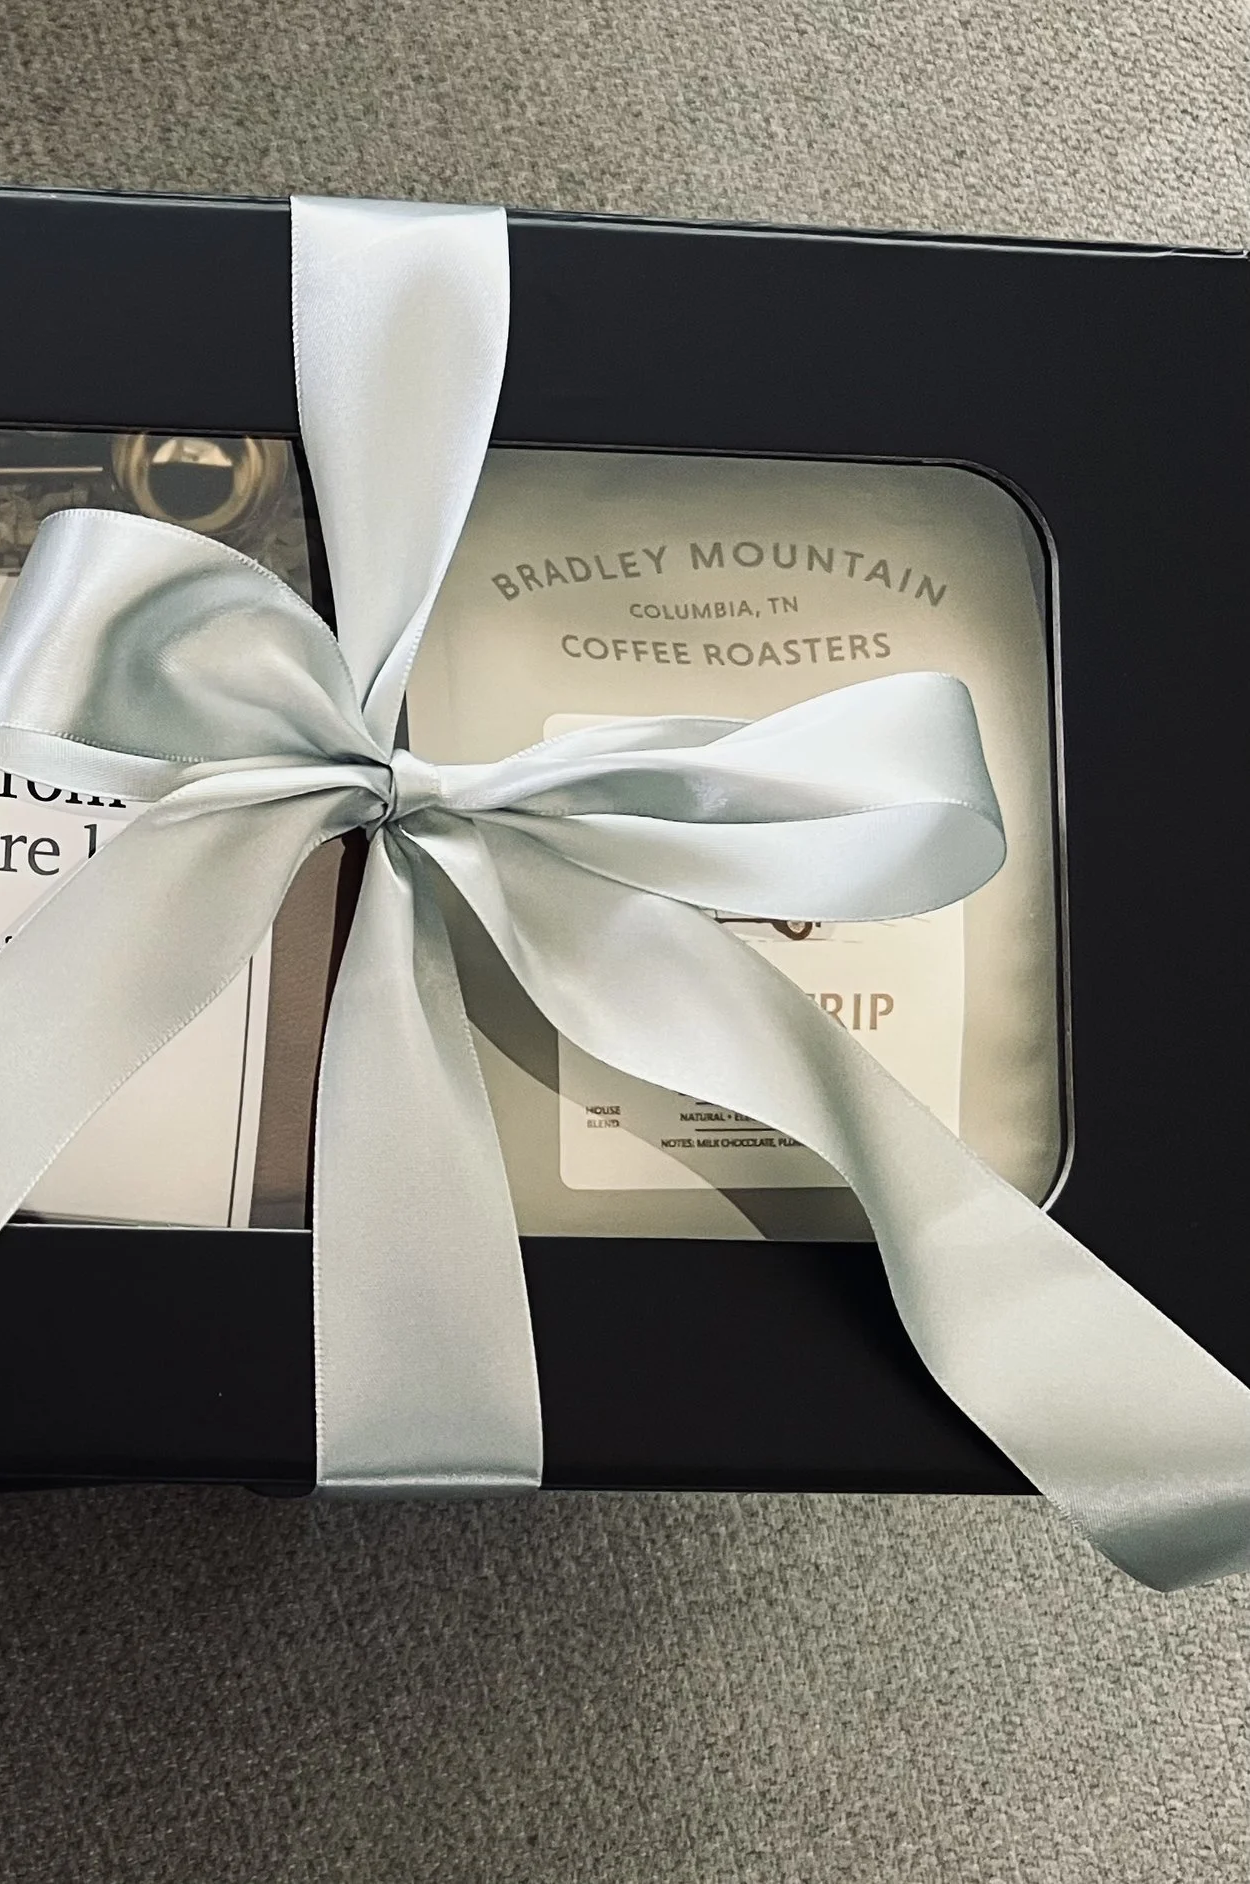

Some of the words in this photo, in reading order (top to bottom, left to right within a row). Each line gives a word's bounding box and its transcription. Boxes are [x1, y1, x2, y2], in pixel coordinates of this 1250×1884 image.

[491, 545, 667, 601] BRADLEY
[689, 541, 948, 607] MOUNTAIN
[629, 602, 759, 620] COLUMBIA,
[768, 596, 798, 614] TN
[561, 634, 691, 665] COFFEE
[705, 632, 892, 667] ROASTERS
[805, 993, 894, 1030] RIP
[586, 1105, 621, 1115] HOUSE
[680, 1112, 725, 1122] NATURAL
[697, 1138, 719, 1148] MILK
